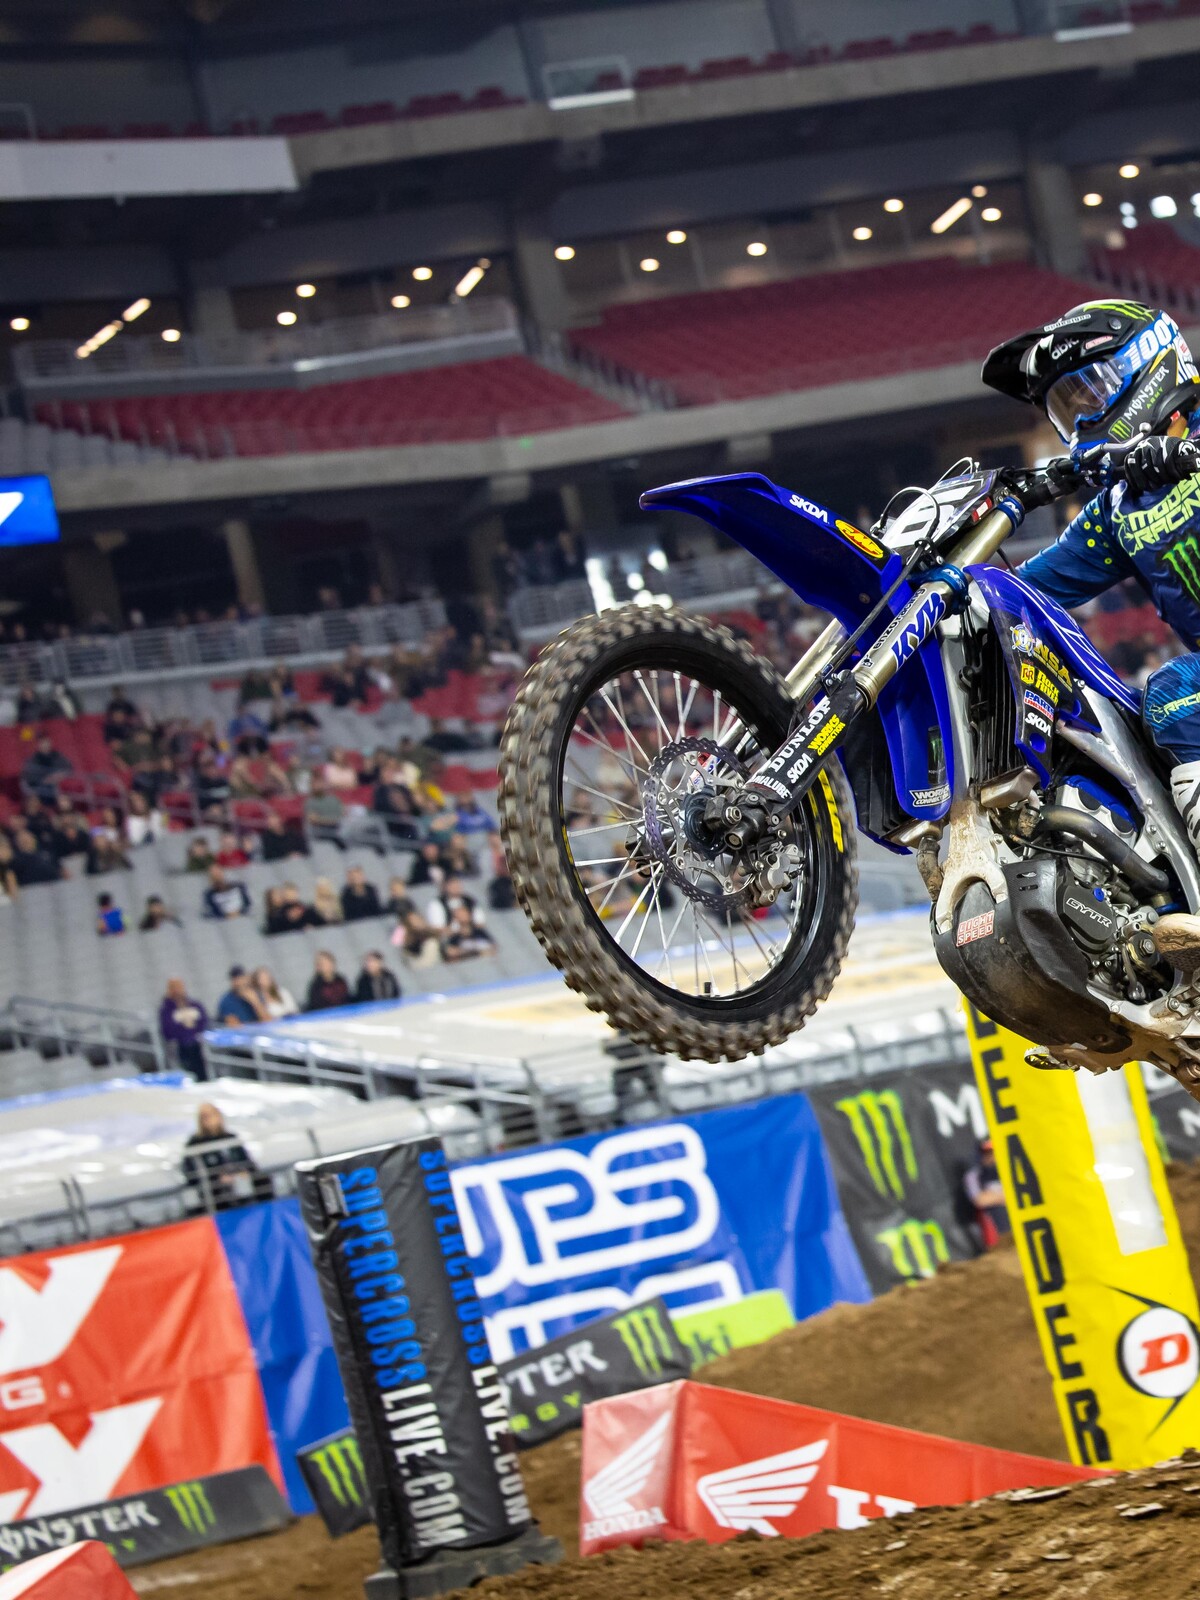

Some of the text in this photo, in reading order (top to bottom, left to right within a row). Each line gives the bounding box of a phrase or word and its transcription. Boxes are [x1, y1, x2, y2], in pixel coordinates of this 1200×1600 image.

[1124, 365, 1170, 420] MONSTER
[789, 494, 830, 524] SKDA
[890, 592, 946, 673] KYB
[1035, 680, 1059, 707] RIVER
[1038, 669, 1060, 696] ROCK
[1024, 689, 1055, 714] PARTS
[768, 698, 831, 773] DUNLOP
[807, 714, 840, 751] WORKS
[817, 721, 846, 757] CONNECTION
[1025, 712, 1052, 738] SKDA
[787, 753, 814, 784] SKDA
[753, 775, 793, 799] MALUBE
[914, 784, 950, 799] WORKS
[959, 911, 994, 933] LIGHT
[1066, 897, 1113, 928] GYTR
[957, 924, 994, 947] SPEED
[928, 1083, 989, 1140] M
[0, 1500, 161, 1560] ONSTER
[584, 1505, 669, 1542] HONDA
